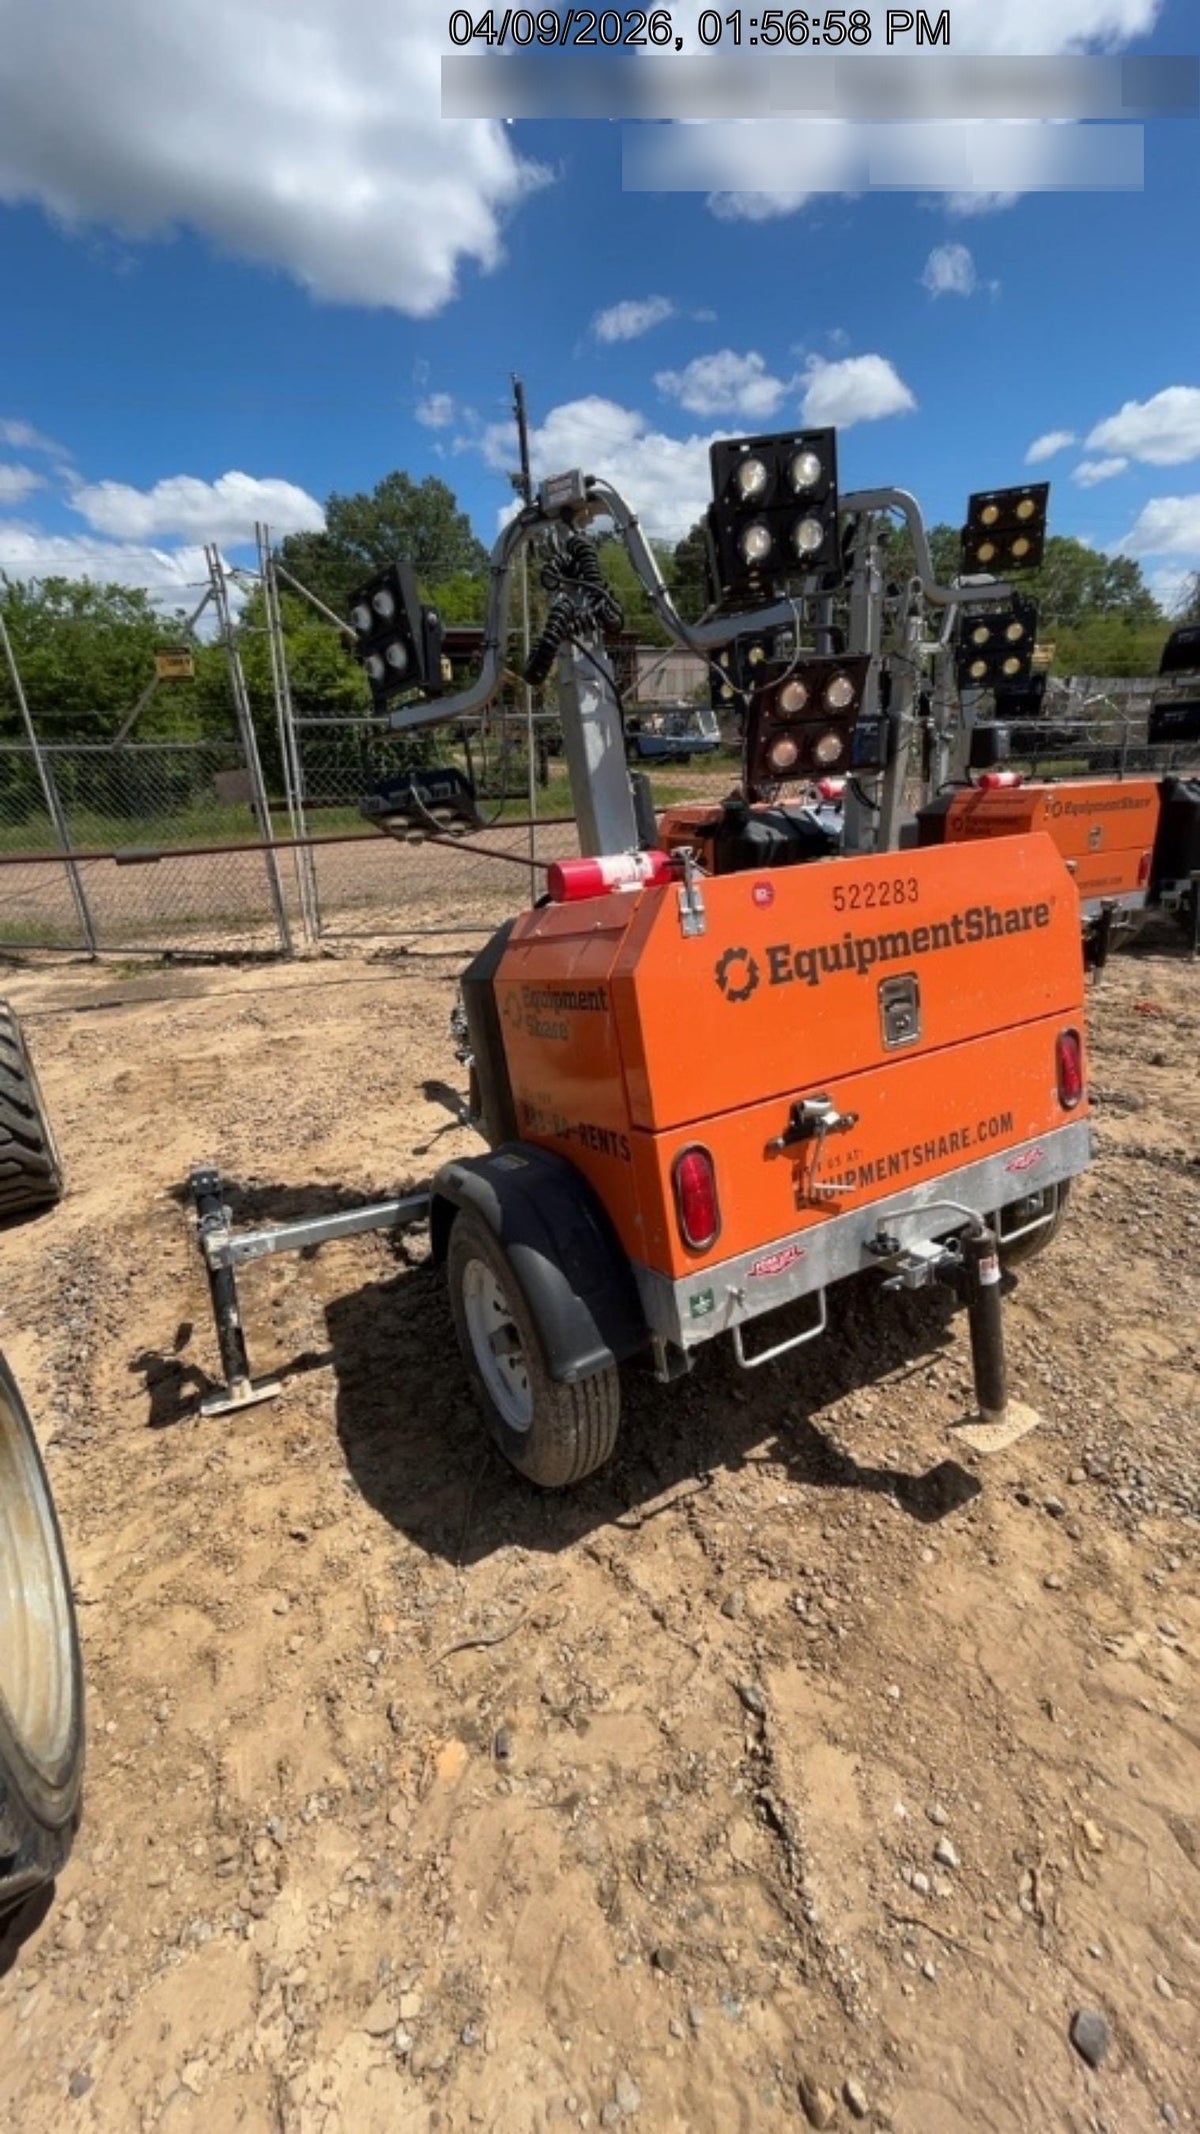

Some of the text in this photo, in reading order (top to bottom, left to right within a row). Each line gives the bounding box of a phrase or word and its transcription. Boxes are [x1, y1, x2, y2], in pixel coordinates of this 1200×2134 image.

[832, 877, 919, 911] 522283
[767, 900, 1051, 987] EquipmentShare
[521, 985, 608, 1015] Equipment
